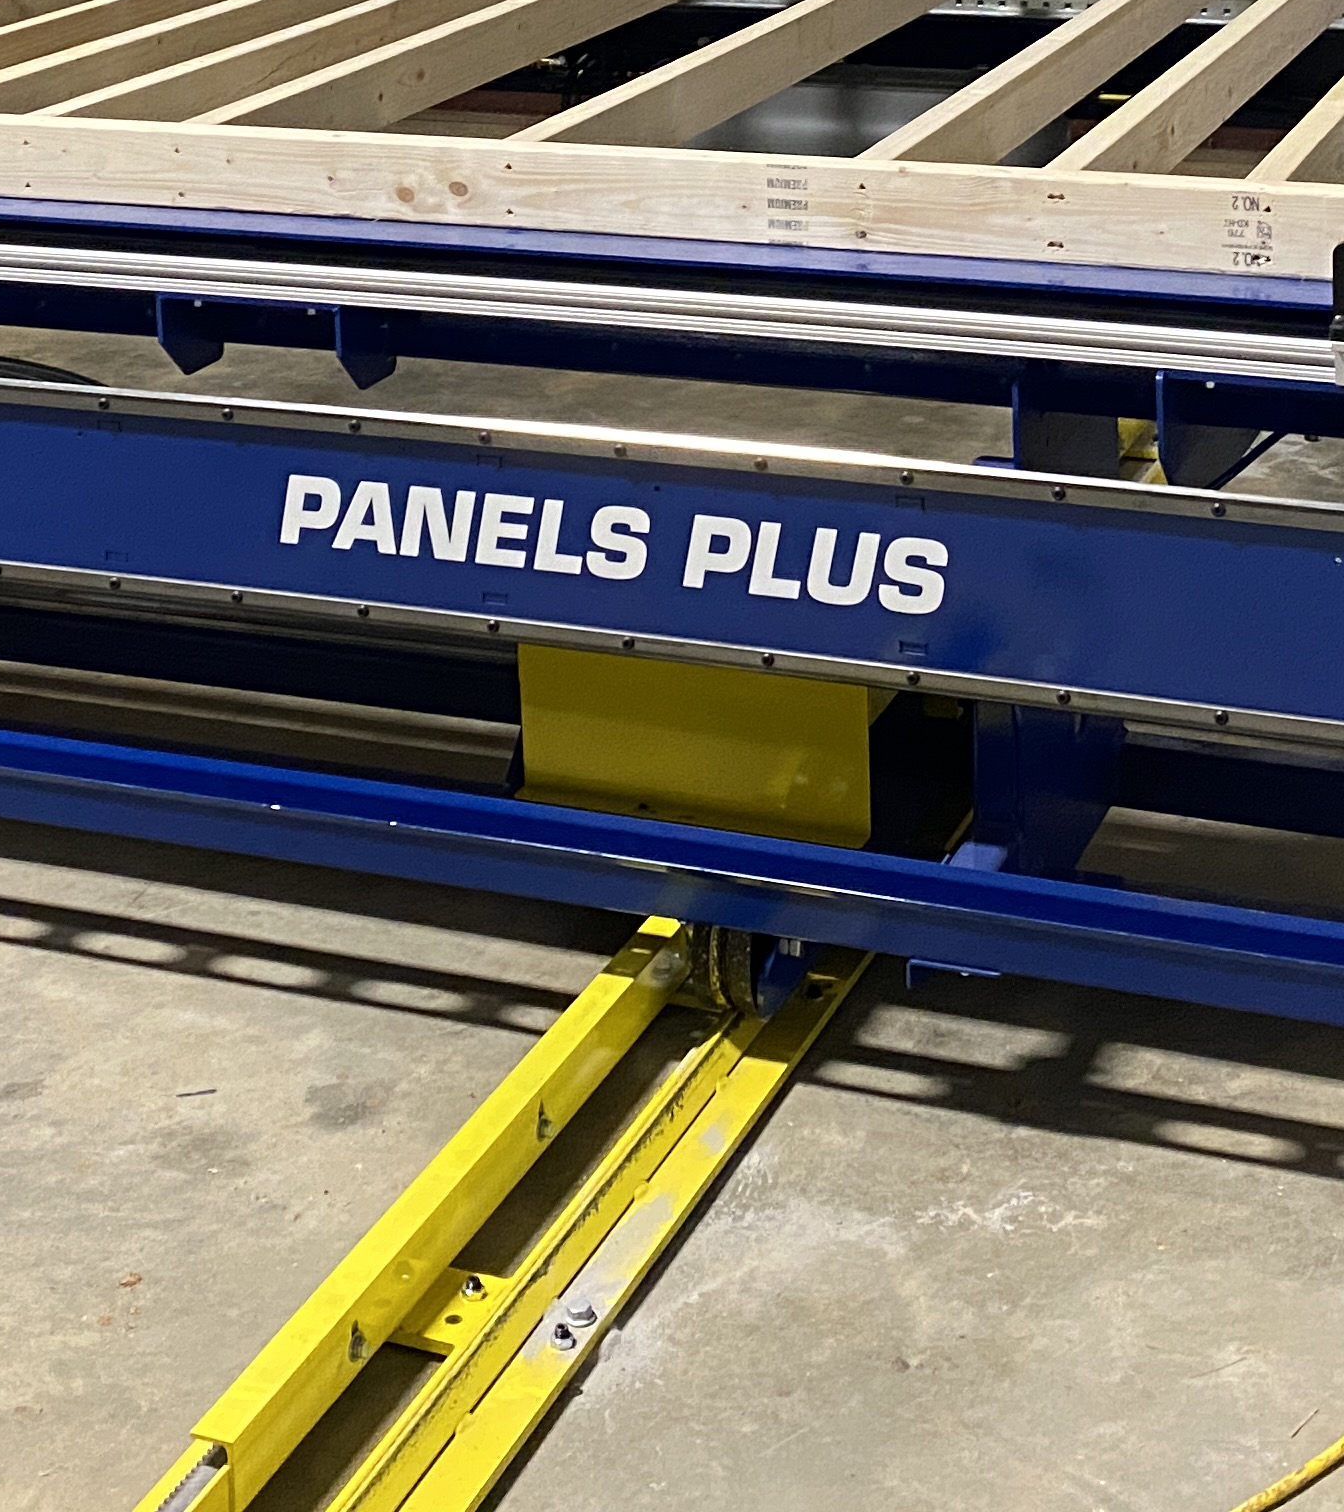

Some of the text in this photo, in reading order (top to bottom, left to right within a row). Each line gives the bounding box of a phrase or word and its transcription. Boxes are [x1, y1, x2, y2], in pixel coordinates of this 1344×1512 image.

[1231, 195, 1239, 211] 2
[279, 474, 950, 616] PANELS PLUS
